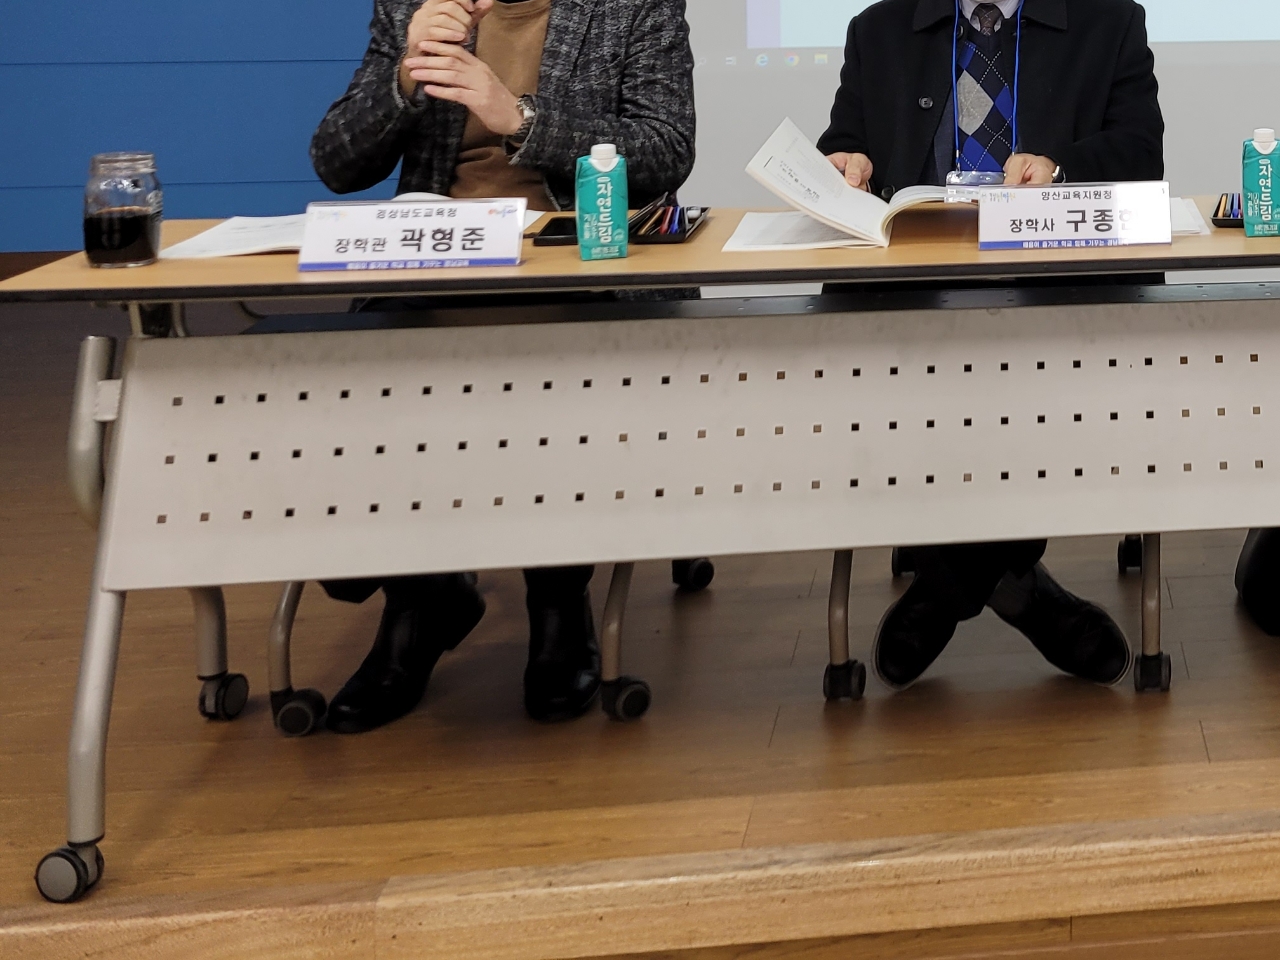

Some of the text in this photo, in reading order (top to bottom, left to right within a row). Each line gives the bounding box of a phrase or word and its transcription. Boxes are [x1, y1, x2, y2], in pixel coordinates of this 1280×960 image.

[1041, 190, 1112, 201] 양산교육지원청
[1258, 163, 1273, 221] 자연드림
[376, 207, 458, 220] 경상남도교육청
[596, 181, 614, 244] 자연드림
[1010, 218, 1055, 233] 장학사
[335, 226, 486, 254] 장학관 곽형준
